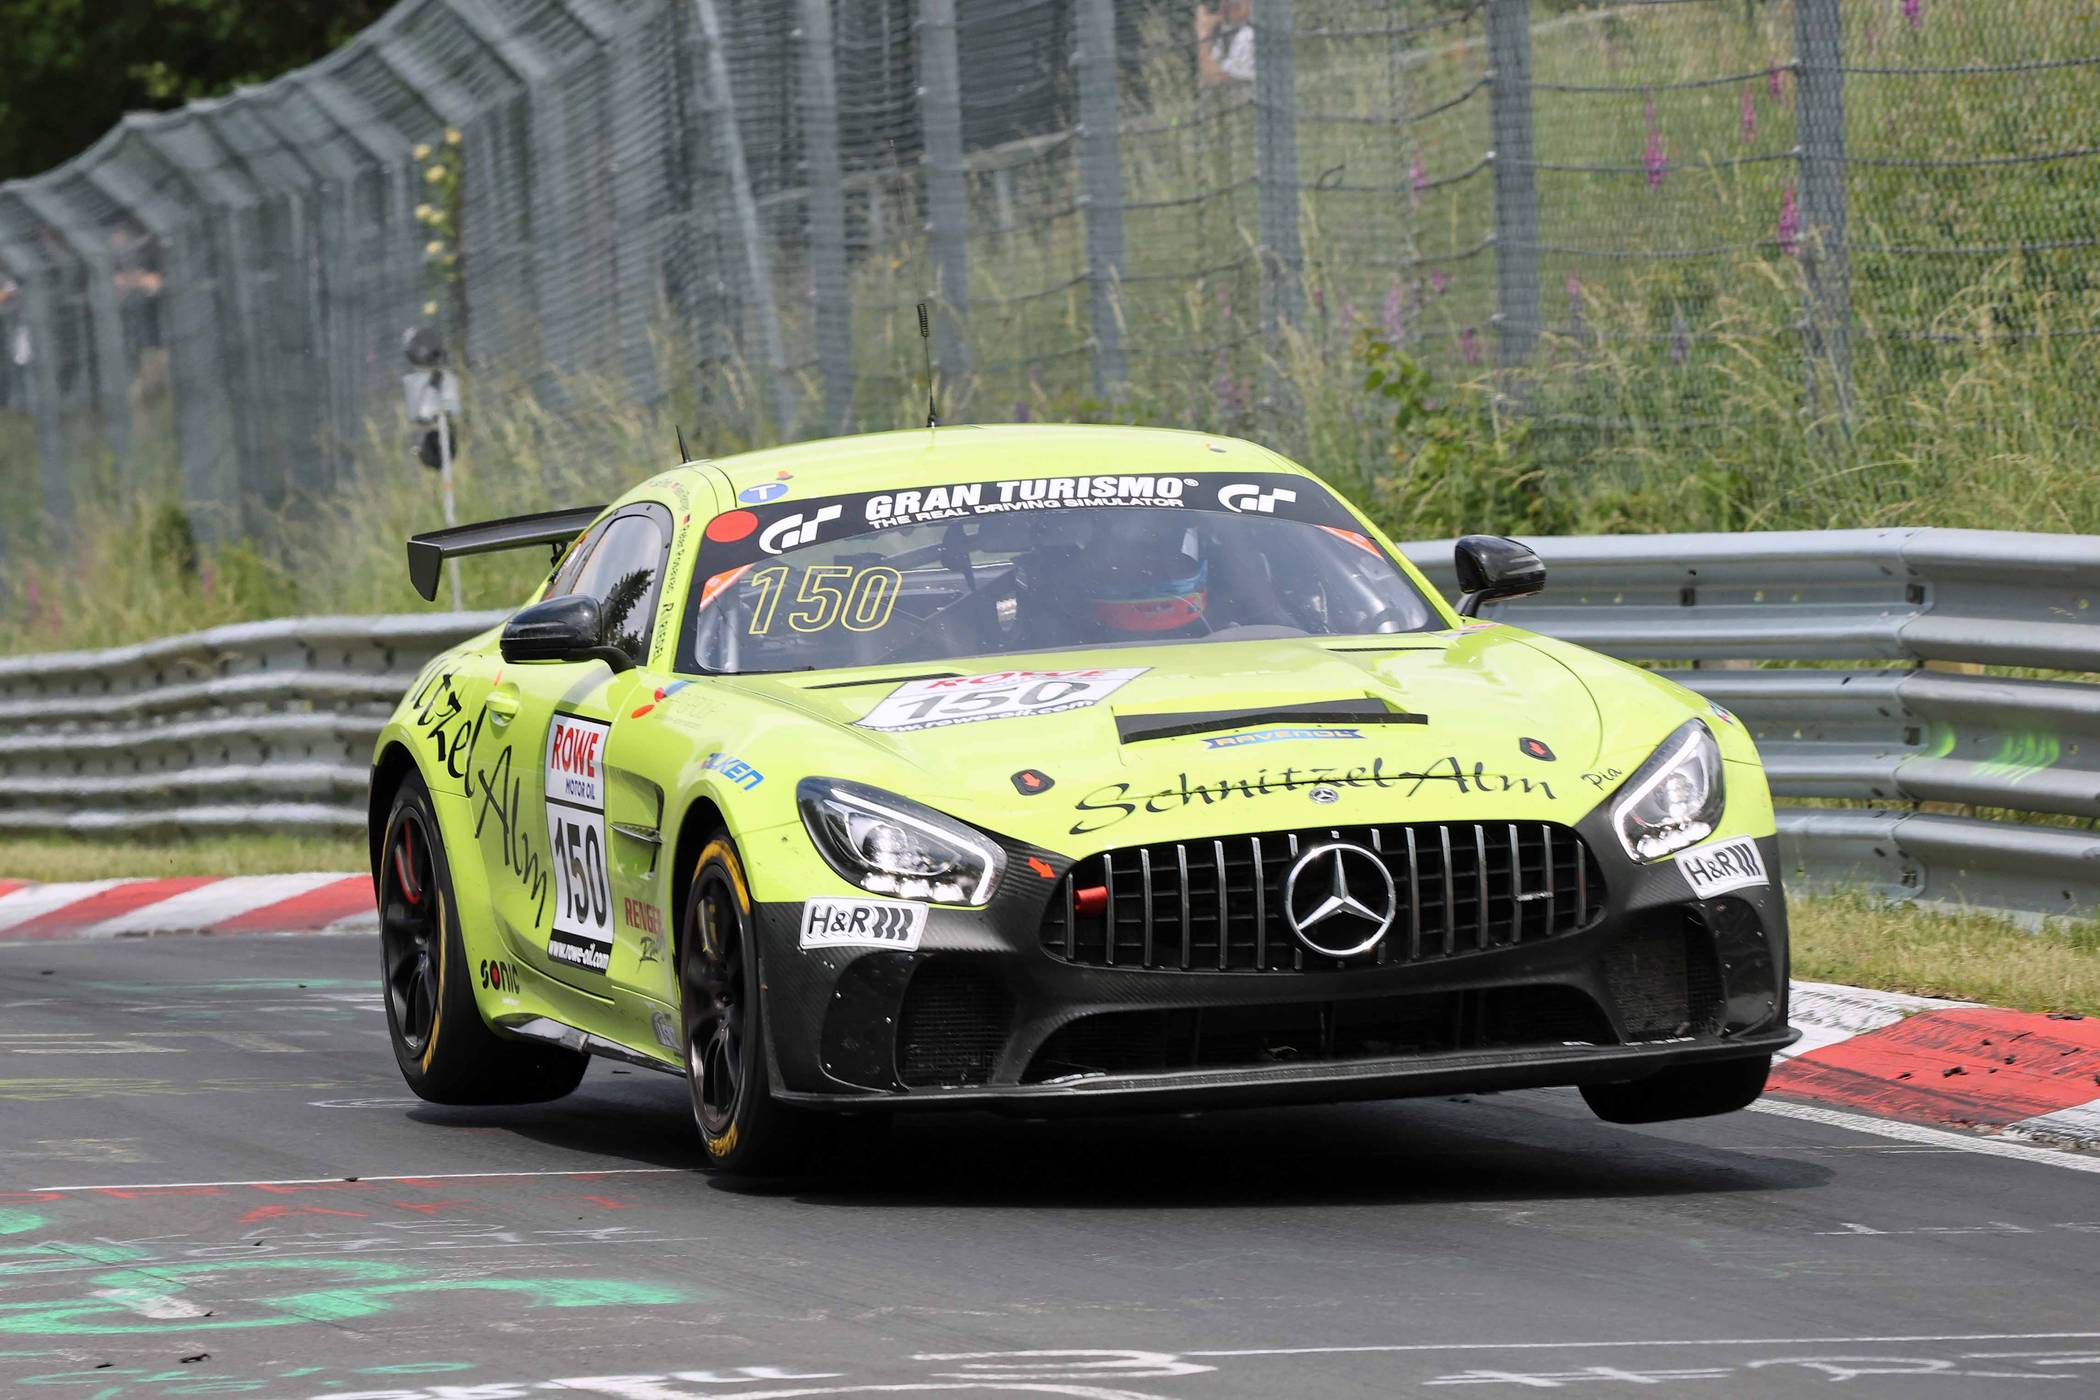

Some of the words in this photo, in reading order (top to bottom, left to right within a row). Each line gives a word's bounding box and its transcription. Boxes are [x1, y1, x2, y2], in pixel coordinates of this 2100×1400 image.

[865, 484, 982, 521] GRAN
[869, 515, 912, 529] THE
[915, 507, 971, 522] REAL
[974, 498, 1062, 514] DRIVING
[1064, 497, 1185, 508] SIMULATOR
[748, 565, 903, 635] 150
[898, 681, 1091, 720] 150
[550, 724, 601, 779] ROWE
[1214, 728, 1354, 747] RAVENOL
[565, 778, 586, 797] MOTOR
[586, 782, 596, 801] OIL
[1069, 757, 1396, 835] Schnitzel
[1399, 756, 1557, 800] Alm
[554, 817, 607, 929] 150
[1684, 851, 1740, 887] H&R
[808, 905, 871, 937] H&R
